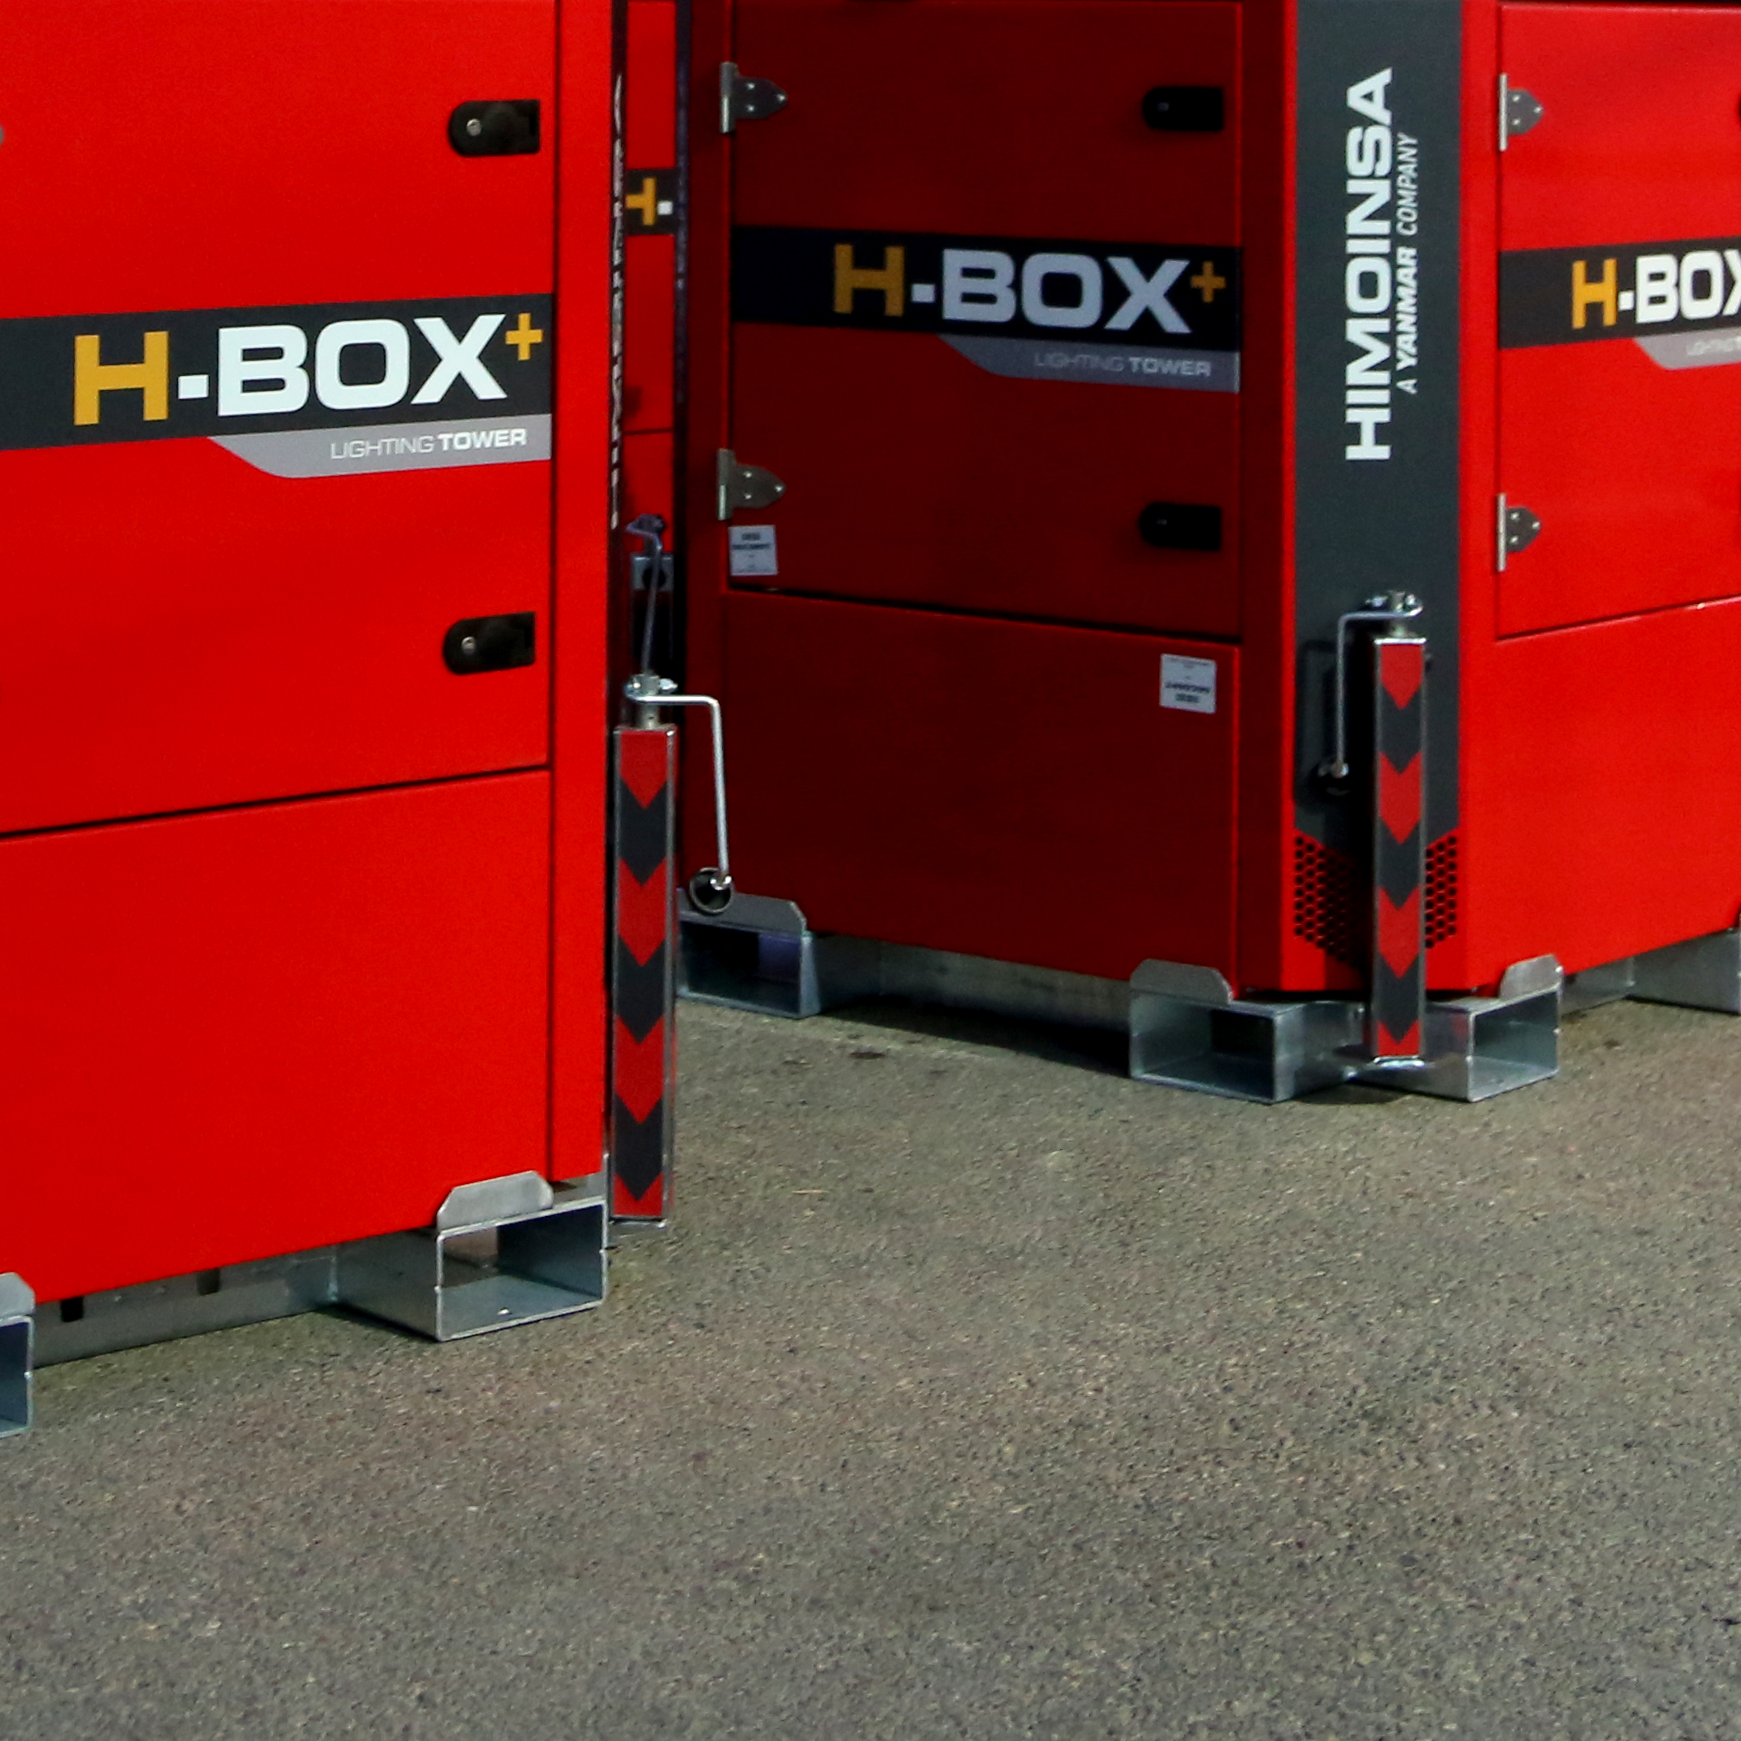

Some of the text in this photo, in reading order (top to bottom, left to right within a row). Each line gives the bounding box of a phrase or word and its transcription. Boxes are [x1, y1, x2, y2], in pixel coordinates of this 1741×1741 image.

[832, 243, 1227, 335] H-BOX+
[1345, 66, 1393, 461] HIMOINSA
[1396, 131, 1419, 395] A YANMAR COMPANY
[73, 311, 544, 427] H-BOX+
[1033, 351, 1212, 378] LIGHTING TOWER
[329, 427, 527, 460] LIGHTING TOWER
